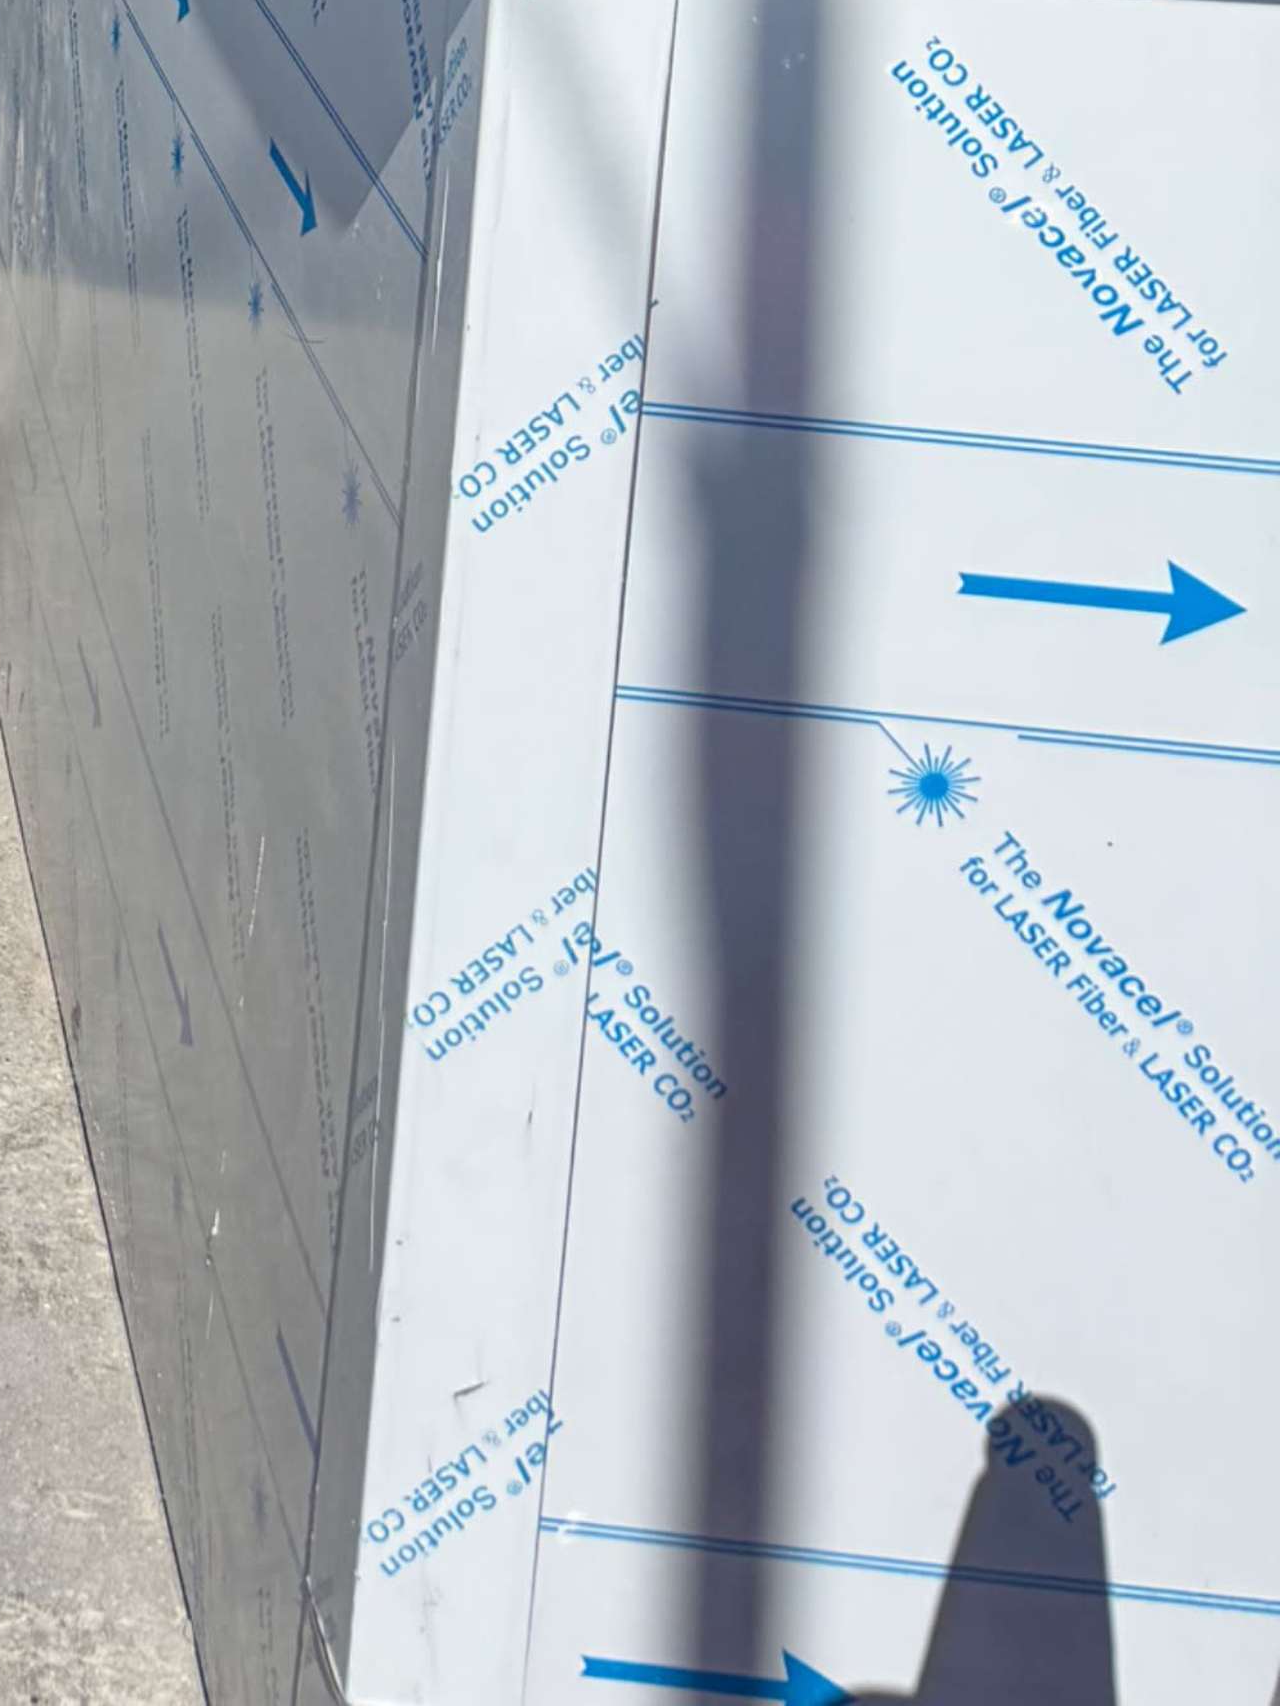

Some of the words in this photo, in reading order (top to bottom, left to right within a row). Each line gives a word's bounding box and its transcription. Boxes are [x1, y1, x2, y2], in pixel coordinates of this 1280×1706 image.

[890, 59, 999, 179] Solution
[964, 84, 1046, 170] LASER
[1041, 162, 1061, 185] &
[1054, 184, 1120, 251] Fiber
[1112, 244, 1194, 331] LASER
[1143, 334, 1193, 395] The
[1187, 328, 1228, 368] for
[494, 391, 582, 466] LASER
[471, 434, 591, 534] Solution
[992, 829, 1043, 890] The
[449, 923, 535, 996] LASER
[958, 854, 1001, 896] for
[992, 892, 1072, 978] LASER
[1065, 972, 1130, 1039] Fiber
[1121, 1036, 1142, 1059] &
[1138, 1051, 1217, 1136] LASER
[425, 965, 544, 1062] Solution
[623, 984, 729, 1101] Solution
[790, 1196, 895, 1314] Solution
[860, 1221, 940, 1307] LASER
[936, 1299, 956, 1321] &
[948, 1319, 1012, 1386] Fiber
[1005, 1380, 1084, 1465] LASER
[402, 1443, 489, 1514] LASER
[1034, 1464, 1084, 1524] The
[1077, 1460, 1118, 1501] for
[379, 1485, 498, 1578] Solution
